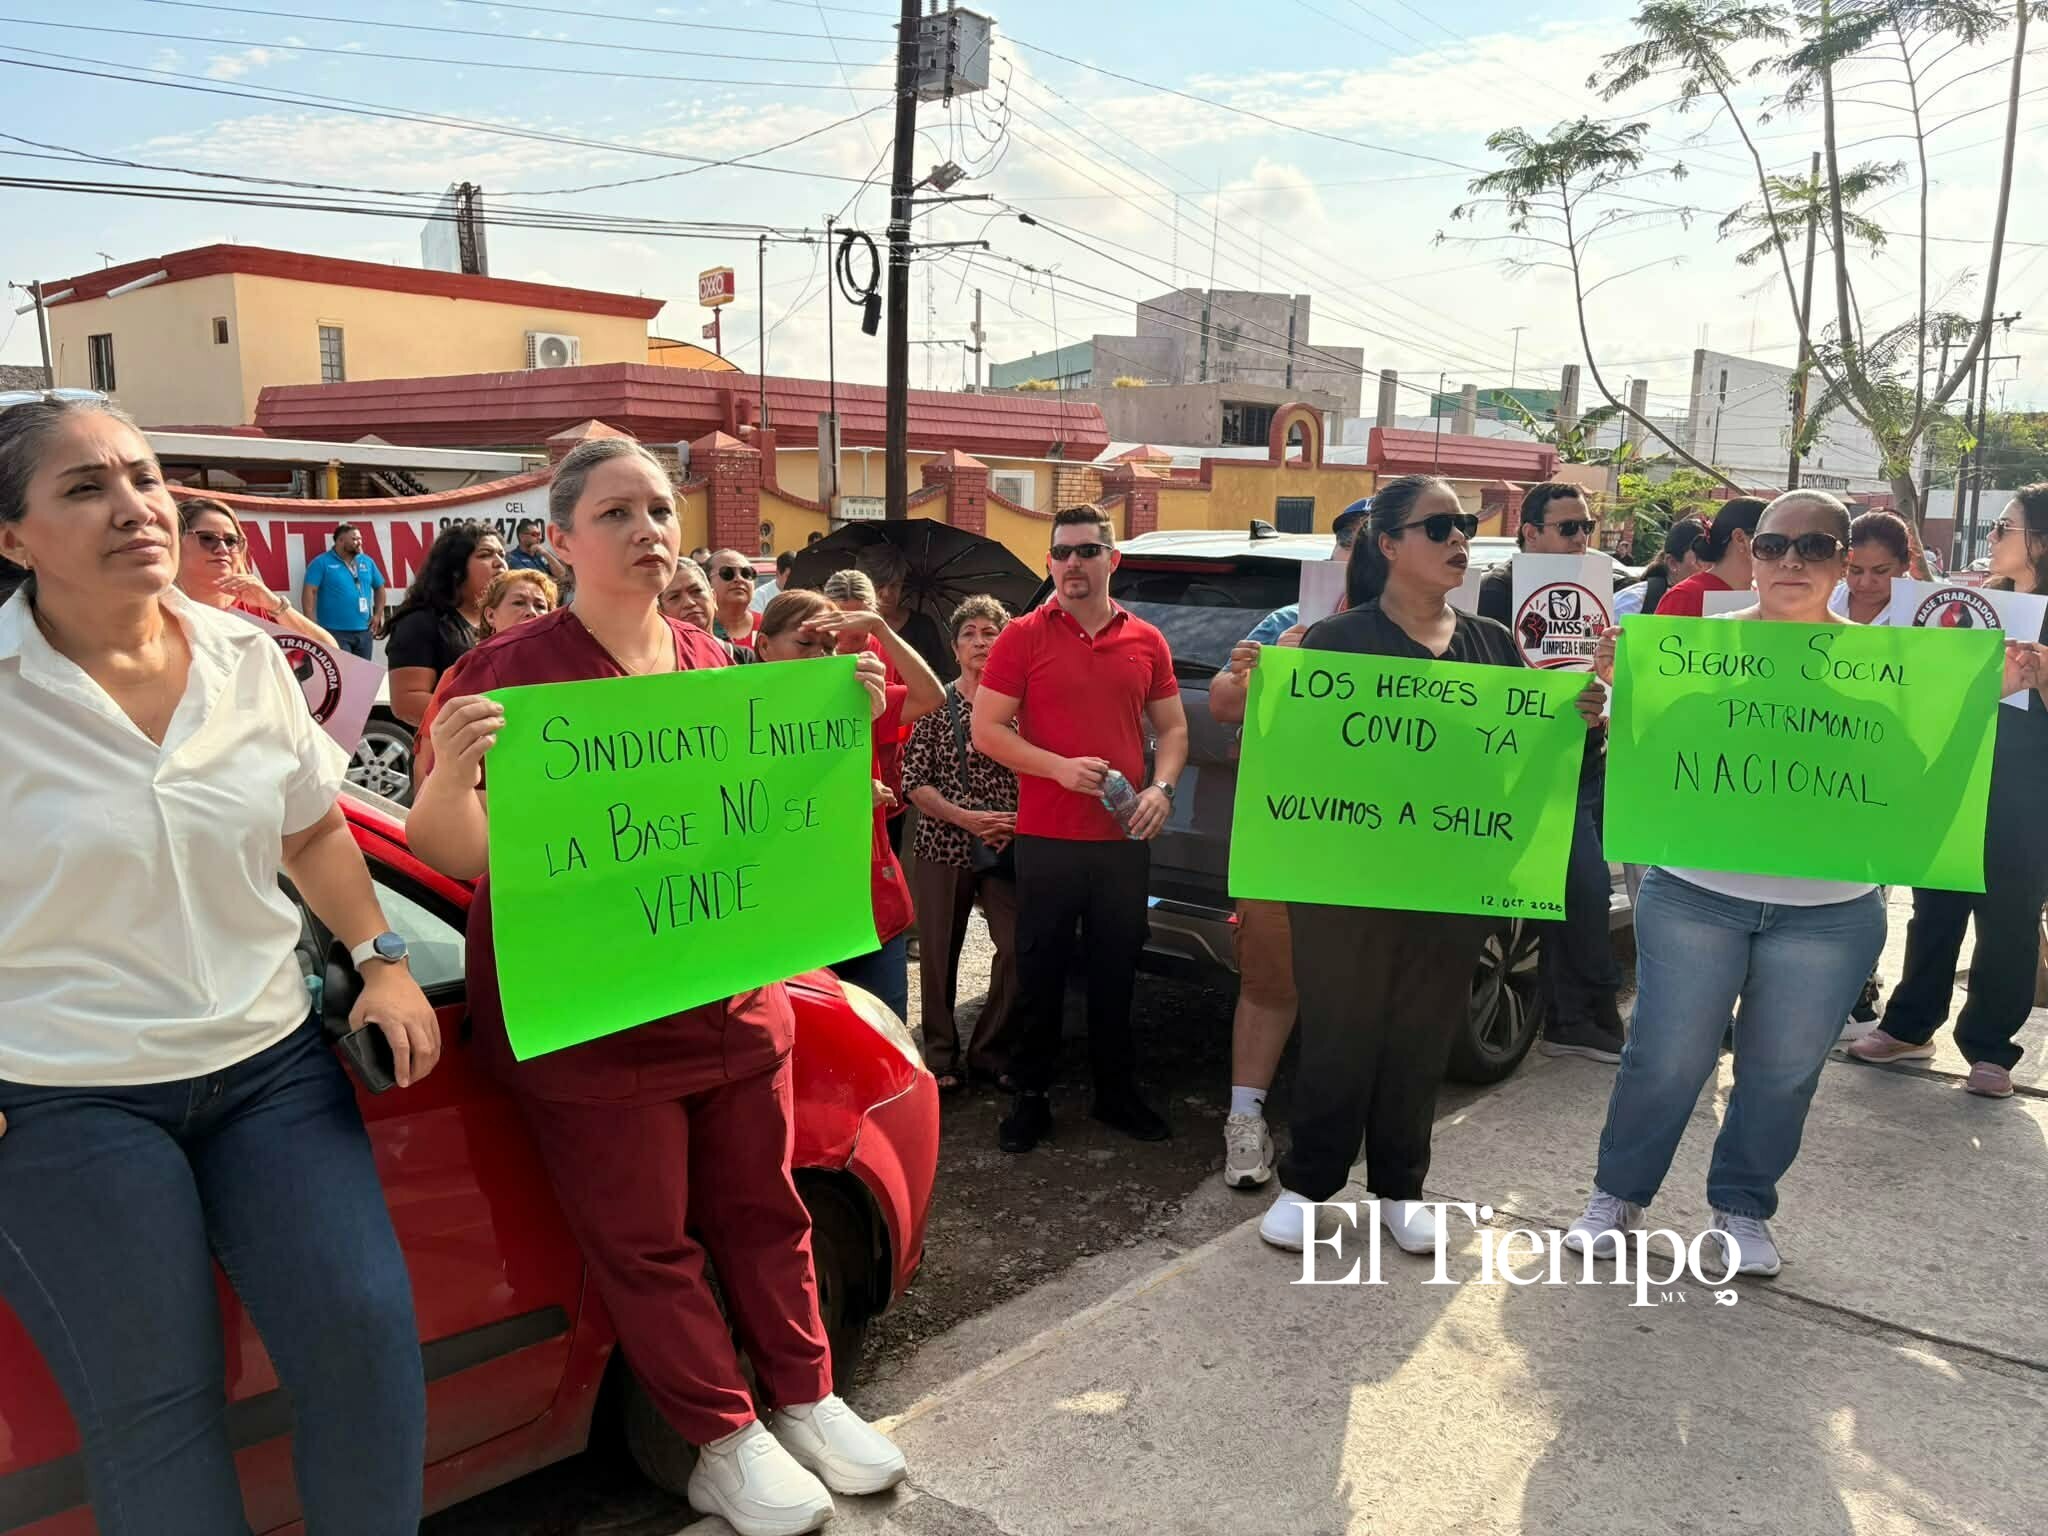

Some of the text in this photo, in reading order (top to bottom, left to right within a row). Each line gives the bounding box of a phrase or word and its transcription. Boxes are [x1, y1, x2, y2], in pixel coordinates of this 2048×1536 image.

[700, 275, 724, 298] OXXO
[505, 502, 525, 513] CEL
[1548, 621, 1582, 634] IMSS
[1917, 591, 1998, 629] BASE TRABAJADOR
[281, 638, 338, 690] TRABAJADORA
[1542, 641, 1573, 655] LIMPIEZA
[1574, 641, 1578, 655] E
[1659, 632, 1911, 686] SEGURO SOCIAL
[1290, 668, 1556, 719] LOS HEROES DEL
[541, 697, 865, 780] SINDICATO ENTIENDE
[1342, 711, 1518, 754] COVID YA
[1718, 698, 1884, 744] PATRIMONIO
[1674, 751, 1888, 806] NACIONAL
[545, 778, 820, 877] LA BASE NO SE
[1267, 794, 1513, 841] VOLVIMOS A SALIR
[634, 863, 761, 936] VENDE
